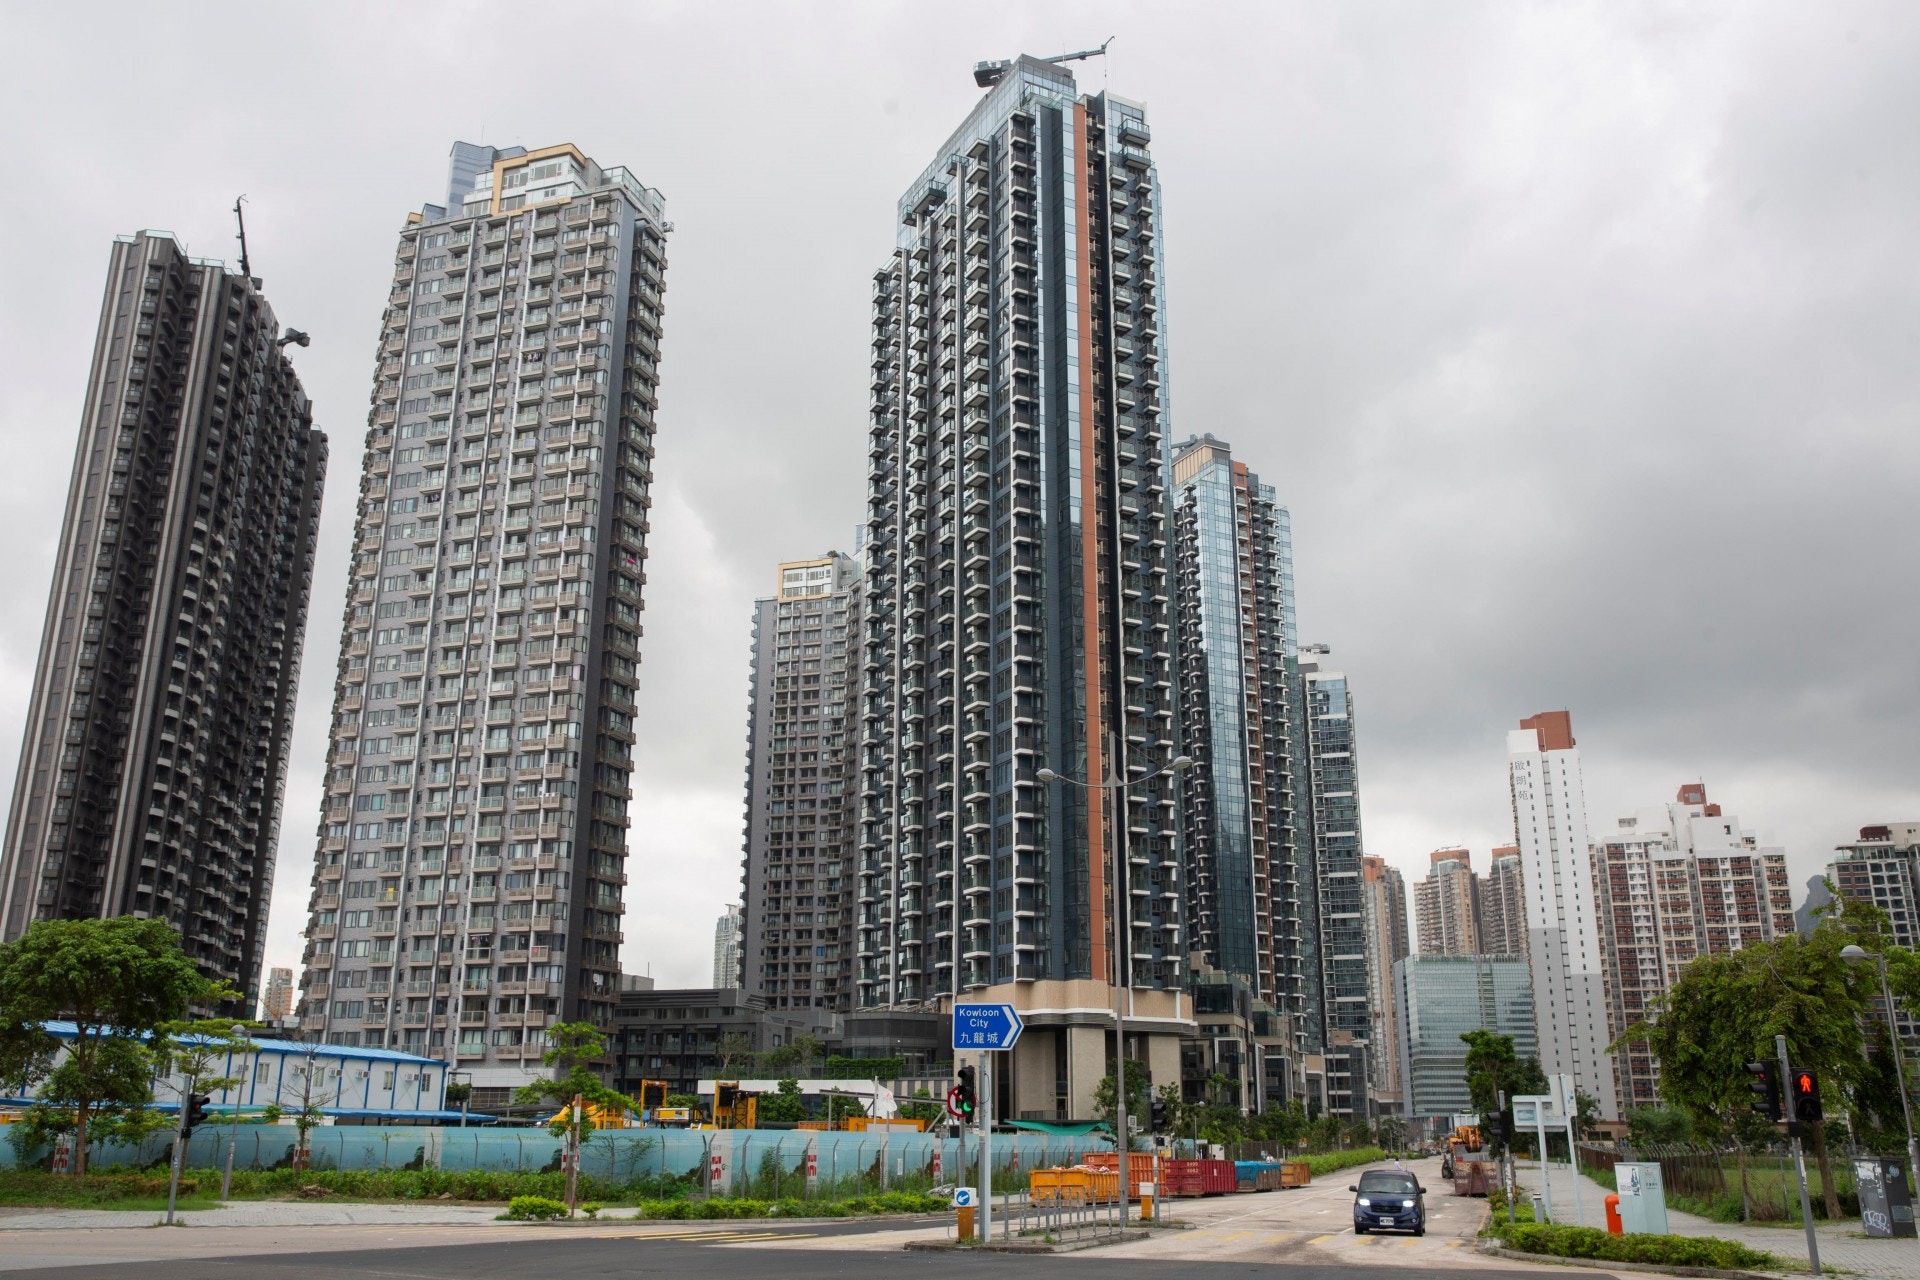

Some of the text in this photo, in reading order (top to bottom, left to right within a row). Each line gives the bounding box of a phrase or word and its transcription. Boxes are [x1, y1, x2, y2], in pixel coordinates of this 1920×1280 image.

[959, 1008, 999, 1017] Kowloon
[969, 1018, 989, 1028] City
[960, 1031, 999, 1044] 九龍城
